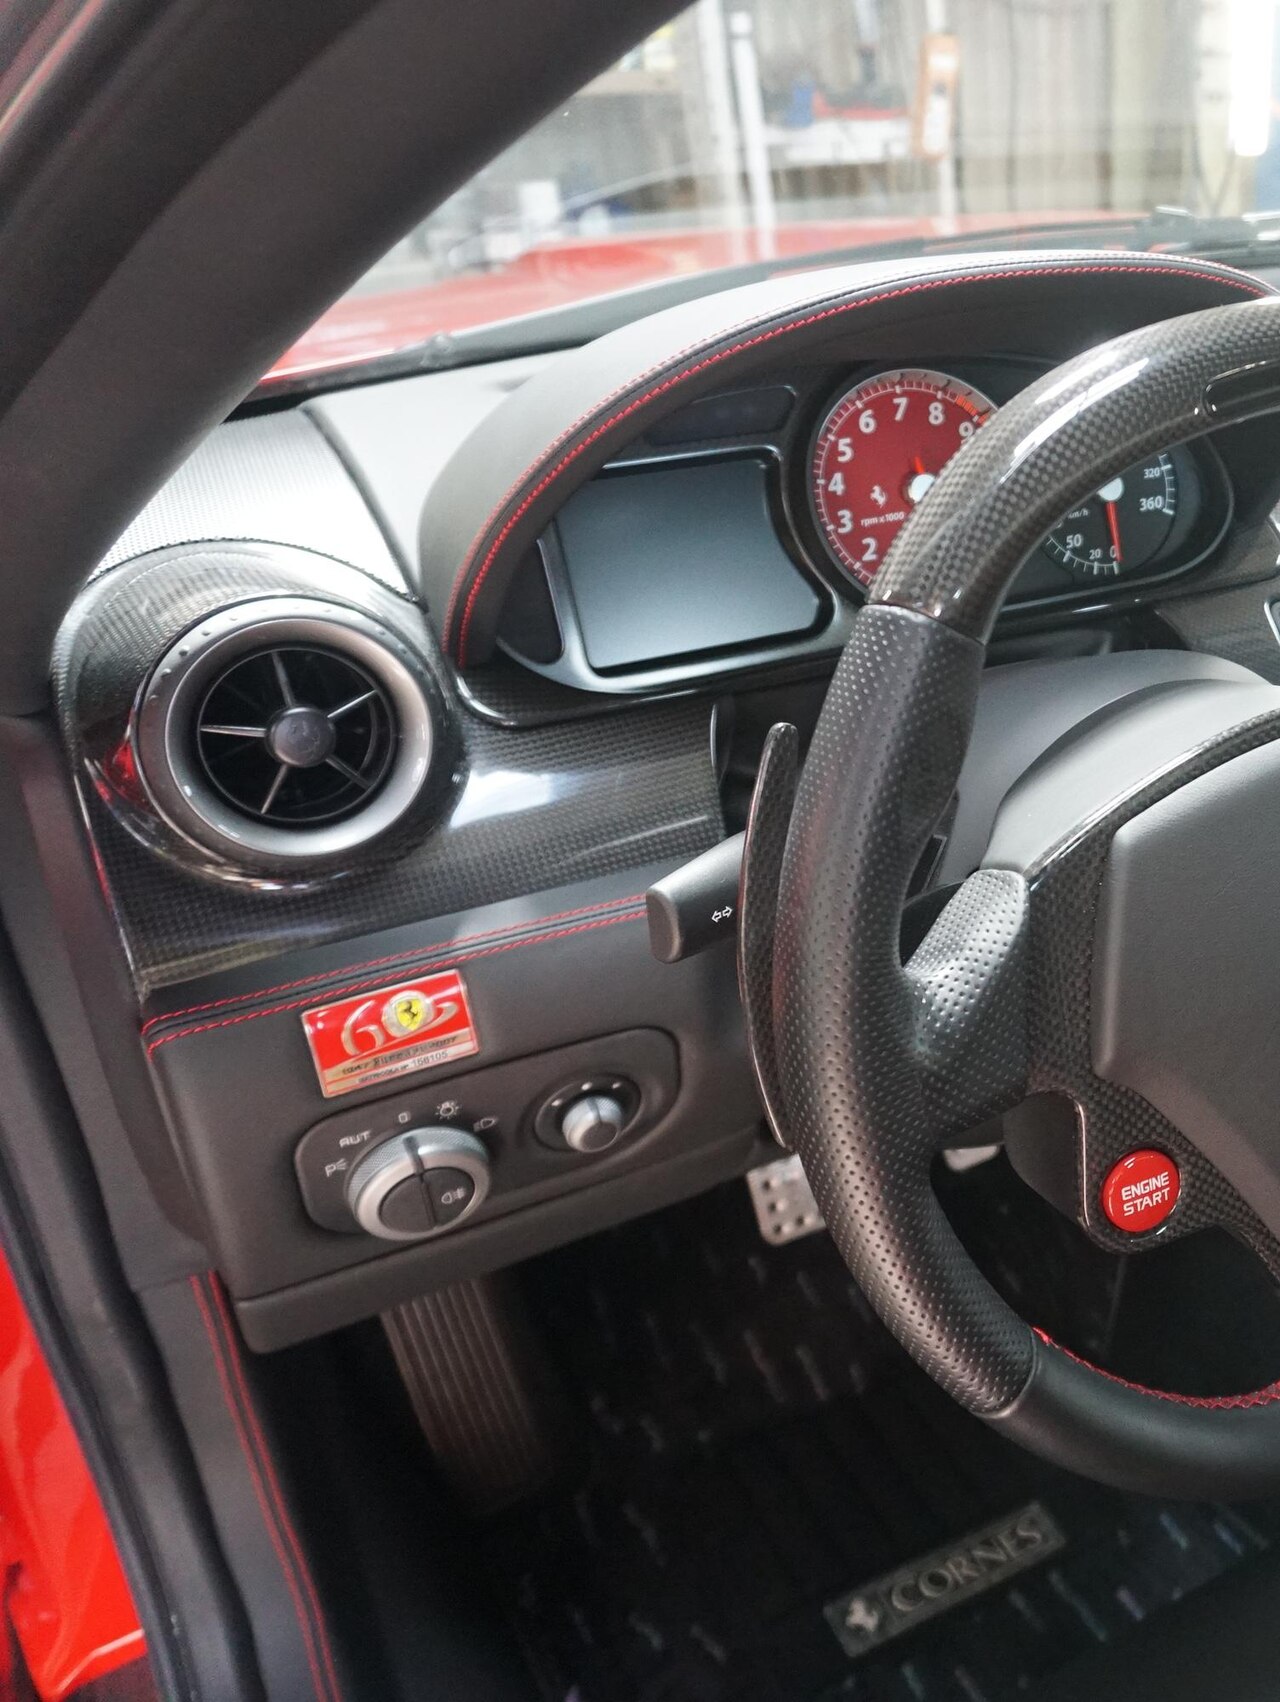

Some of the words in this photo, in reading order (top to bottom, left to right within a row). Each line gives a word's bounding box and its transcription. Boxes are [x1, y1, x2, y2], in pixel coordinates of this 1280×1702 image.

[858, 409, 876, 434] 6
[893, 396, 909, 422] 7
[928, 402, 945, 426] 8
[837, 438, 854, 463] 5
[828, 472, 845, 496] 4
[1143, 467, 1161, 479] 320
[1139, 495, 1163, 512] 360
[837, 509, 853, 534] 3
[861, 514, 878, 527] rpm
[861, 537, 878, 562] 2
[1066, 533, 1083, 549] 50
[1089, 548, 1102, 560] 20
[1121, 1171, 1169, 1201] ENGINE
[1123, 1187, 1170, 1217] START
[890, 1512, 1044, 1613] CORNES
